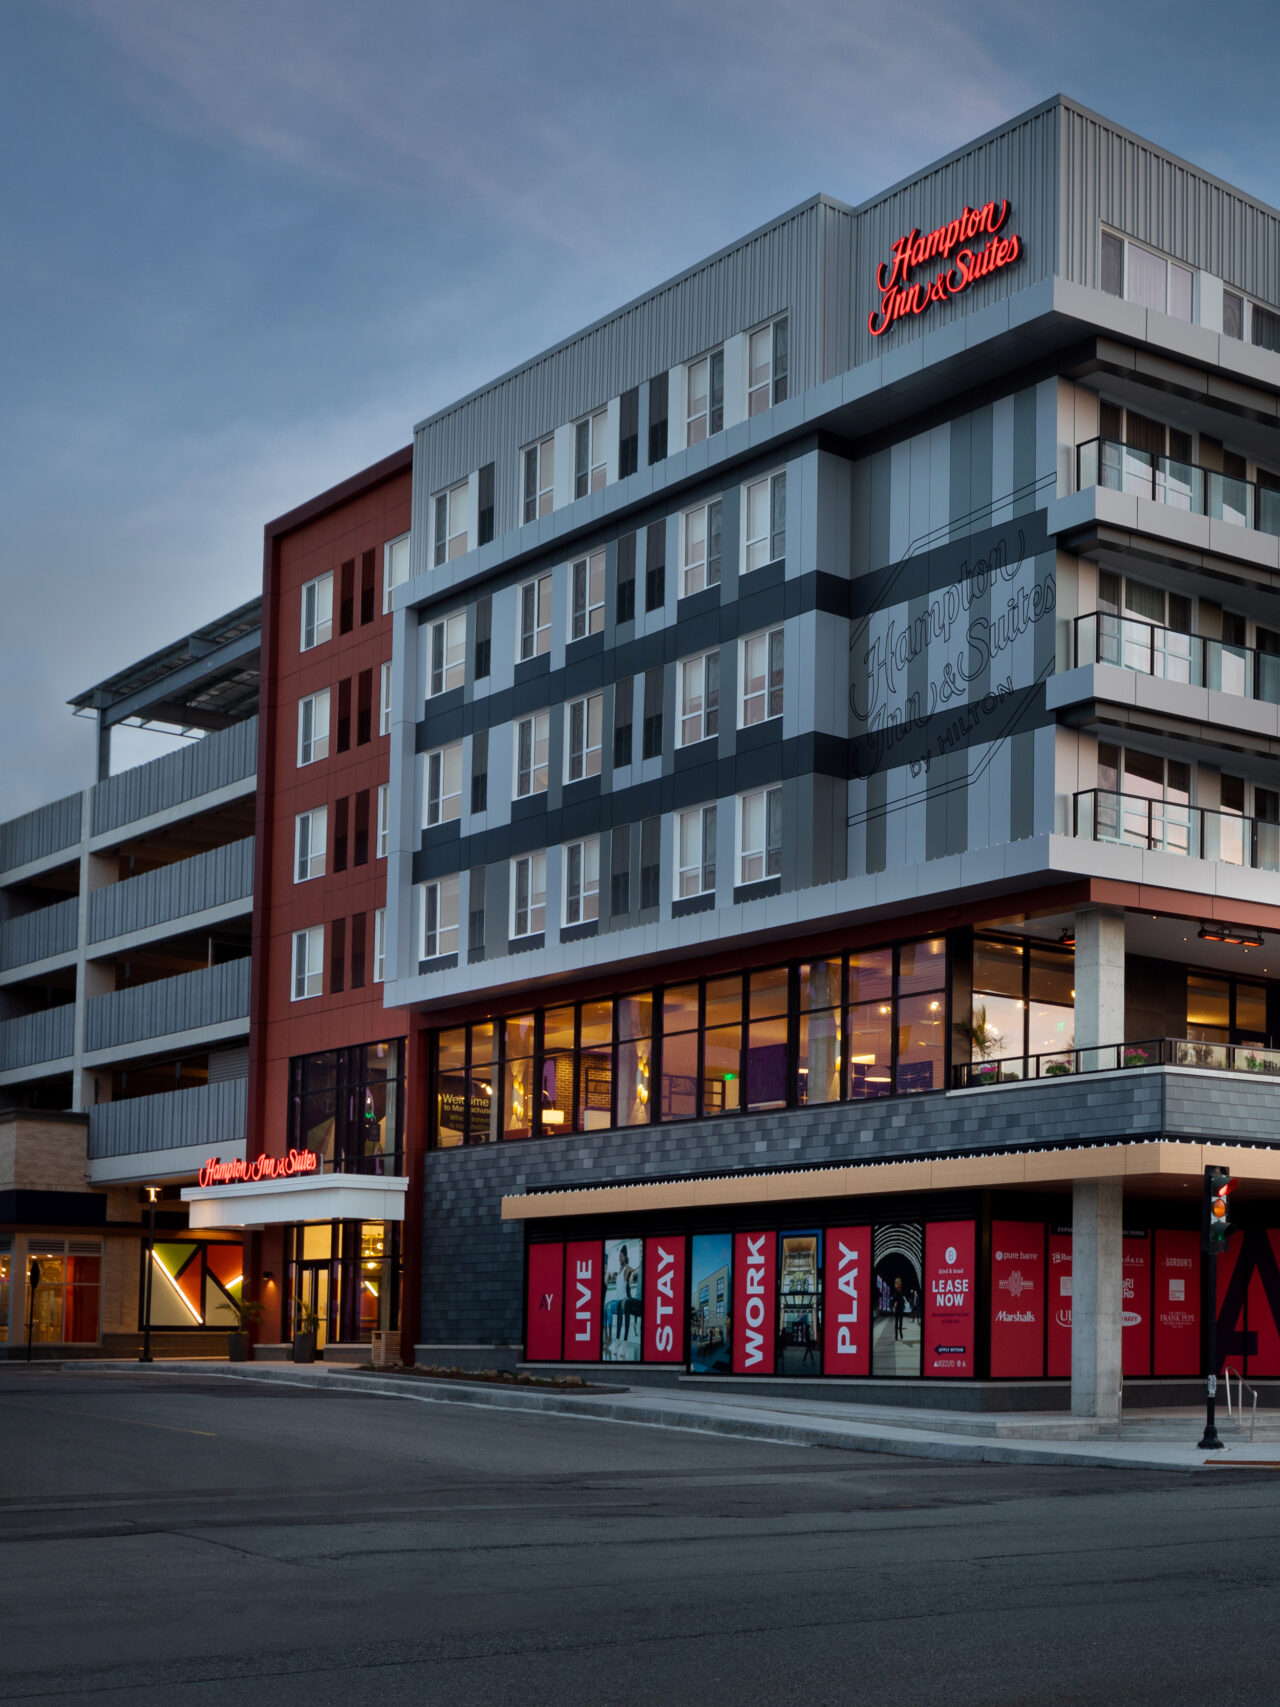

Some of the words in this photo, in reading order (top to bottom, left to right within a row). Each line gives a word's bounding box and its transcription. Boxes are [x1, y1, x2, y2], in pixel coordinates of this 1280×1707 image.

[868, 281, 931, 336] Inn
[931, 273, 949, 300] &
[946, 234, 1019, 293] Suites
[877, 199, 1007, 292] Hampton
[850, 529, 1025, 721] Hampton
[855, 682, 937, 780] Inn
[940, 663, 966, 703] &
[957, 573, 1056, 682] Suites
[937, 675, 1015, 748] HILTON
[199, 1157, 252, 1188] Hampton
[252, 1154, 280, 1181] Inn
[285, 1149, 317, 1174] Suites
[655, 1246, 675, 1352] STAY
[837, 1240, 859, 1354] PLAY
[932, 1279, 969, 1293] LEASE
[1004, 1252, 1019, 1260] pure
[1020, 1251, 1038, 1260] barre
[575, 1259, 592, 1341] LIVE
[744, 1234, 767, 1367] WORK
[936, 1293, 964, 1307] NOW
[995, 1310, 1035, 1322] Marshalls
